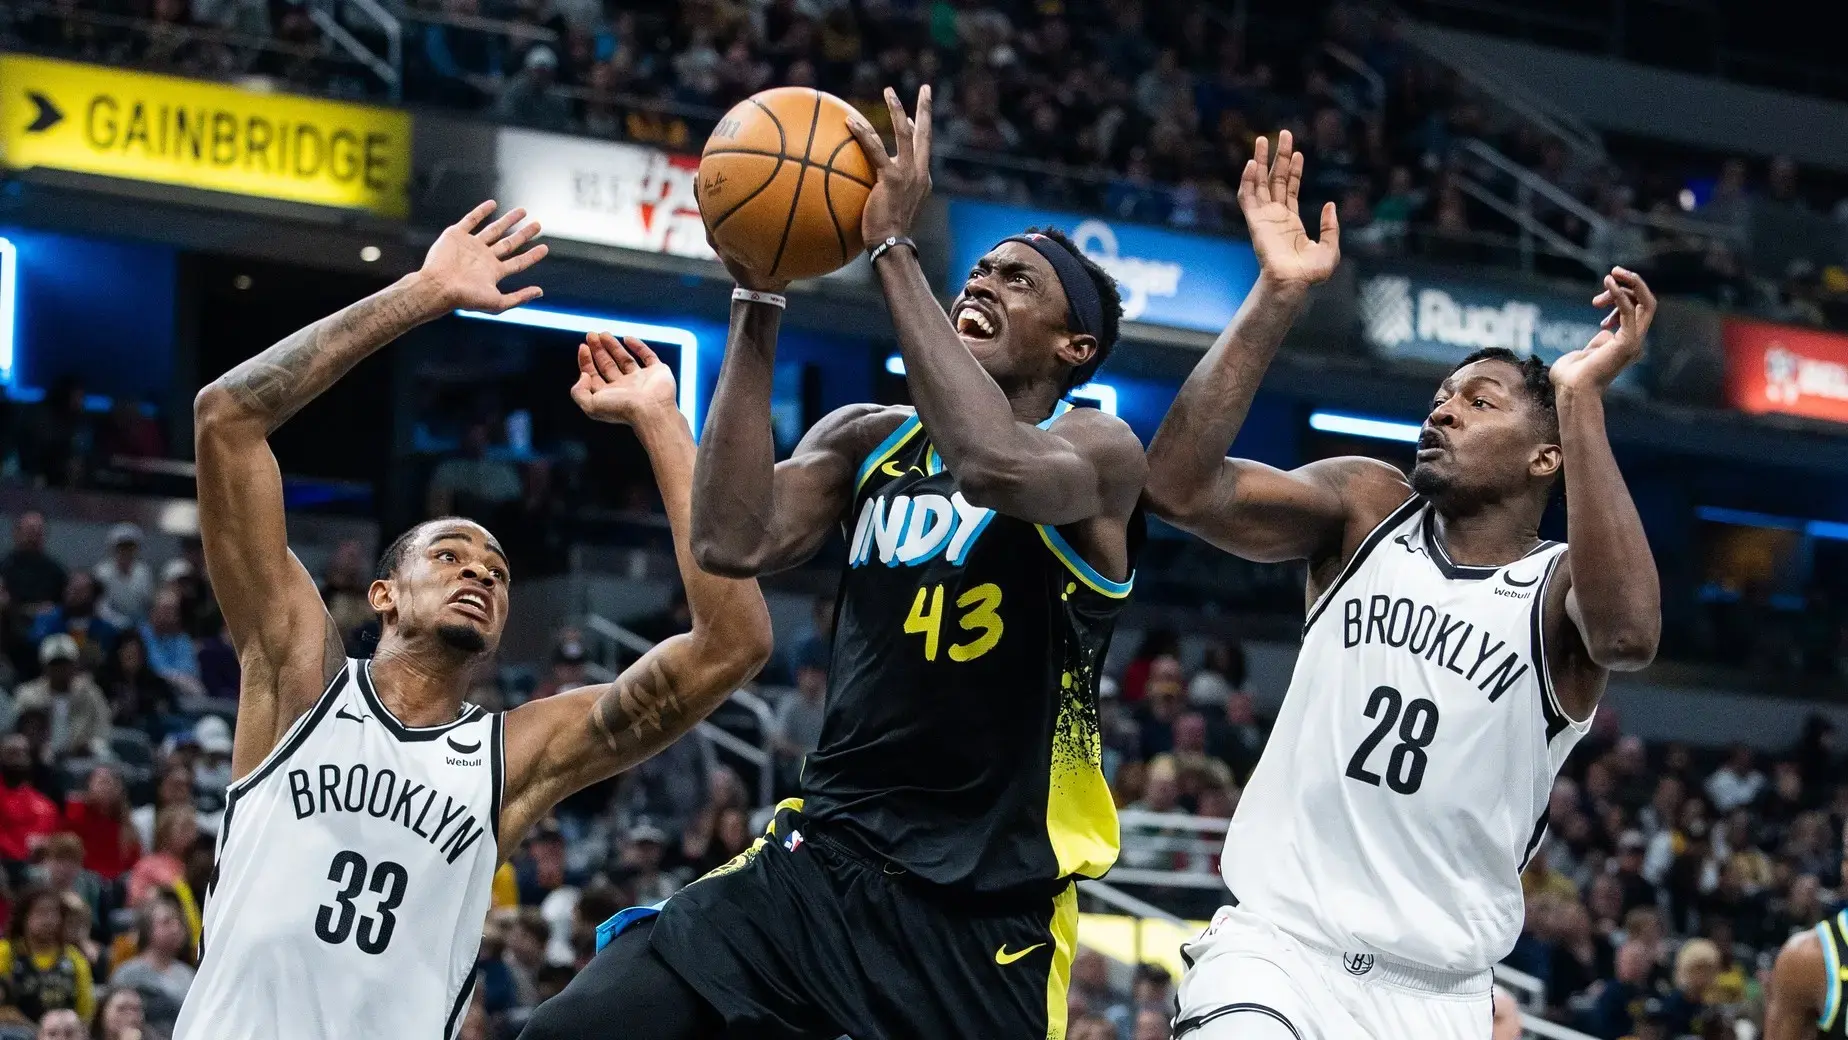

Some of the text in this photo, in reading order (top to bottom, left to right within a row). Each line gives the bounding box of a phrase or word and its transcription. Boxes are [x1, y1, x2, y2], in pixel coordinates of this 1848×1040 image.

[86, 94, 392, 191] GAINBRIDGE
[1418, 290, 1540, 352] Ruoff
[849, 491, 996, 567] INDY
[903, 583, 1003, 661] 43
[1494, 586, 1532, 600] Webull
[1344, 595, 1528, 703] BROOKLYN
[445, 756, 482, 768] Webull
[1345, 686, 1440, 795] 28
[289, 763, 485, 866] BROOKLYN
[314, 850, 409, 954] 33
